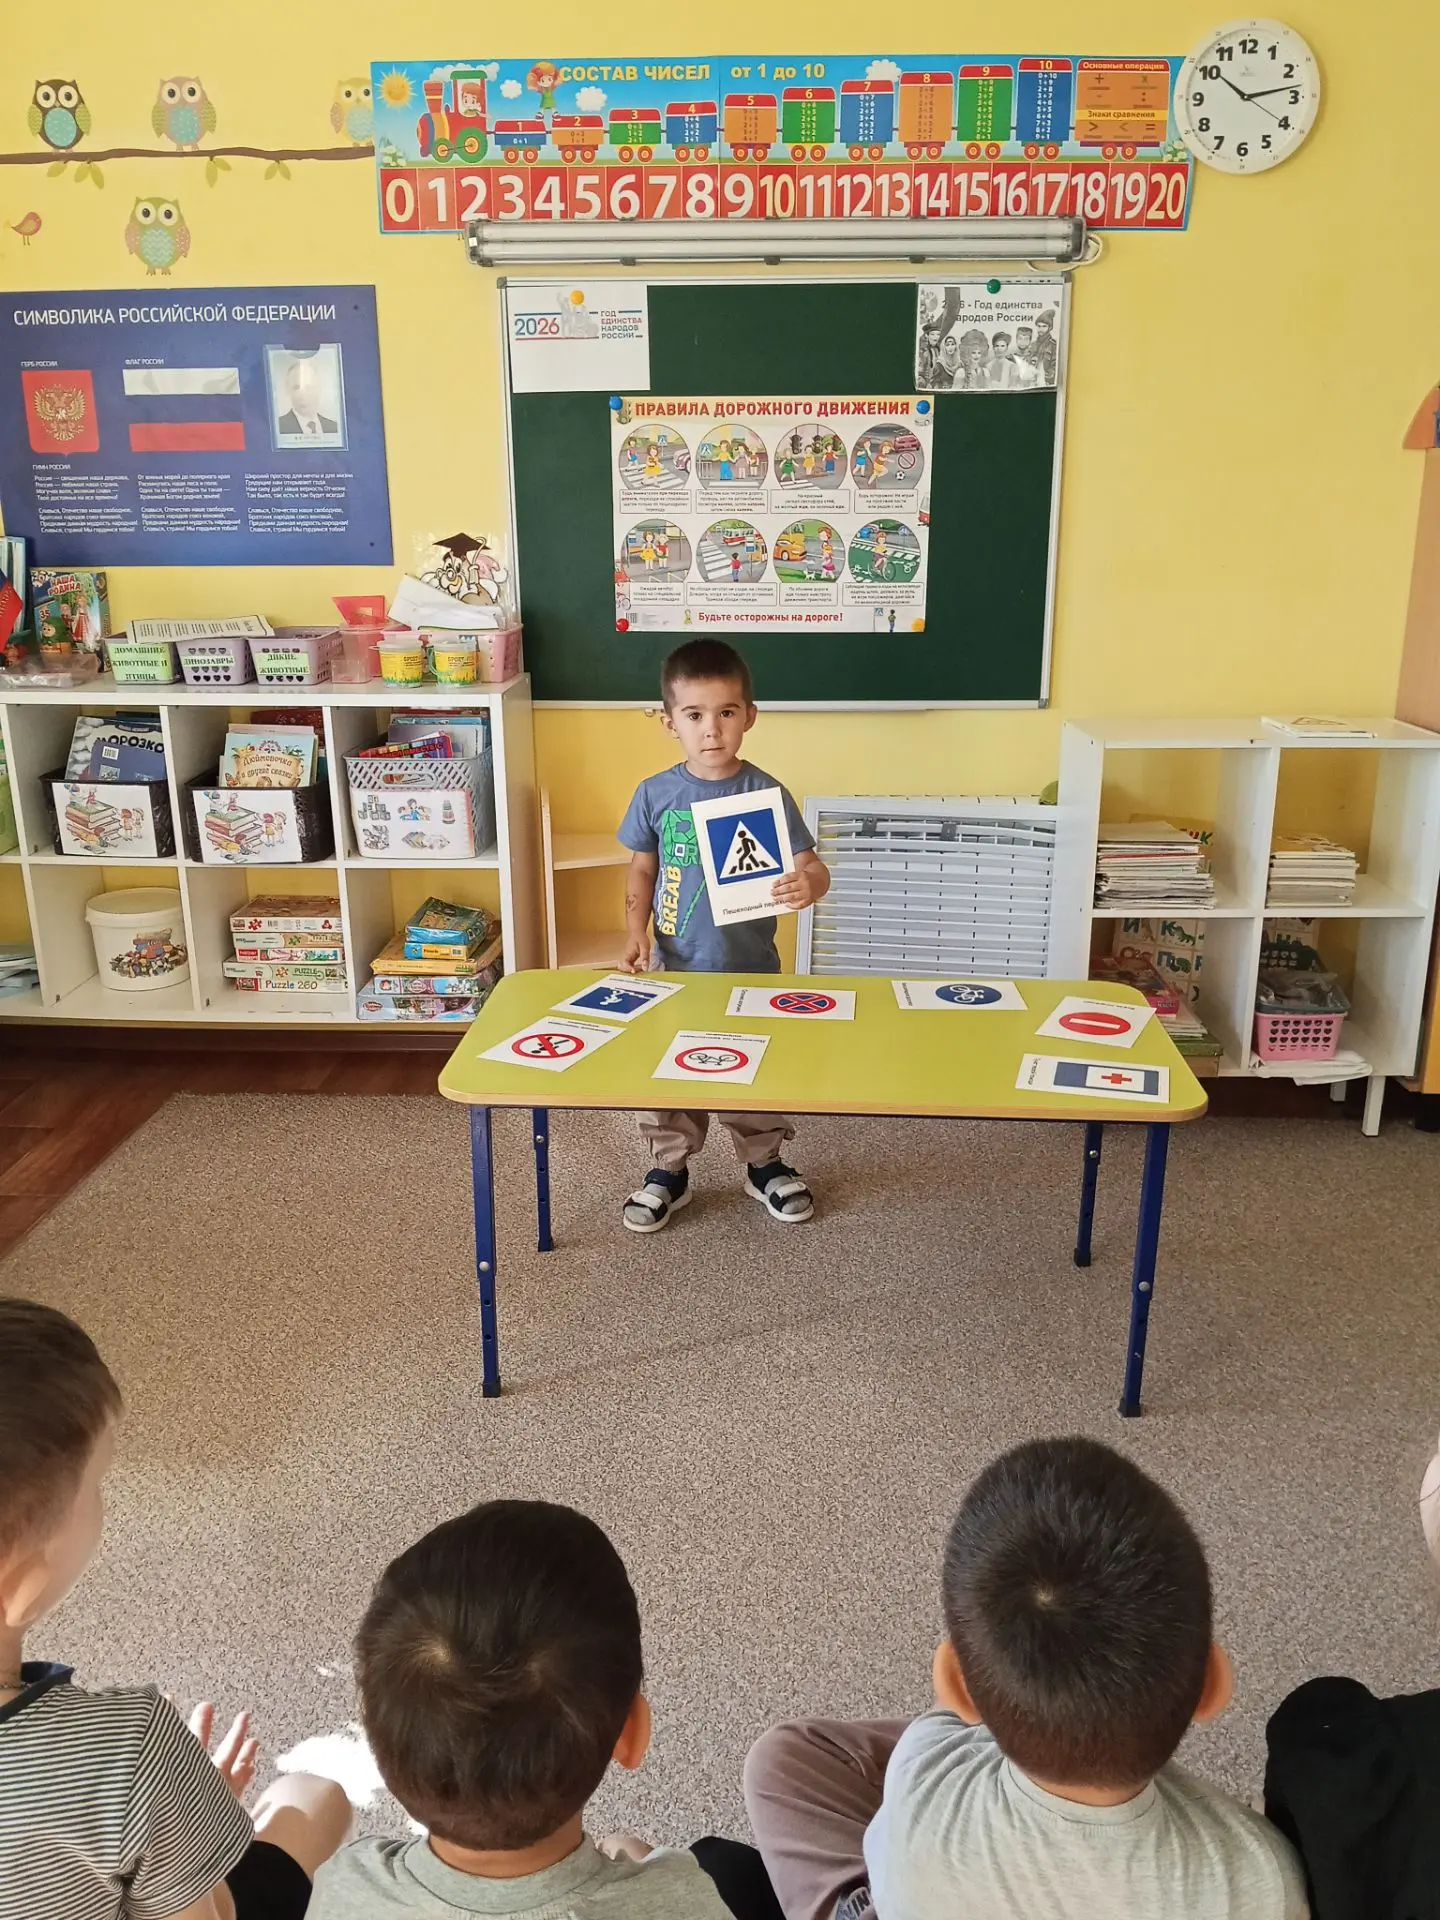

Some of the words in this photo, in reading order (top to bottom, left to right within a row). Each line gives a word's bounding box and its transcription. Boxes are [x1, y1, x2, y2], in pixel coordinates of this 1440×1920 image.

[1239, 39, 1258, 54] 12
[1216, 46, 1233, 61] 11
[1268, 45, 1276, 60] 1
[1040, 61, 1052, 70] 10
[560, 66, 636, 82] СОСТАВ
[644, 64, 711, 81] ЧИСЕЛ
[730, 66, 752, 78] от
[757, 63, 766, 78] 1
[773, 66, 797, 81] до
[803, 64, 825, 78] 10
[982, 67, 990, 76] 9
[1199, 65, 1221, 80] 10
[1283, 64, 1294, 79] 2
[923, 74, 931, 83] 8
[864, 82, 871, 91] 7
[805, 89, 813, 99] 6
[1192, 92, 1204, 106] 9
[1289, 90, 1299, 104] 3
[747, 96, 754, 105] 5
[688, 104, 696, 113] 4
[631, 110, 639, 120] 3
[1113, 111, 1155, 119] сравнения
[517, 122, 523, 131] 1
[574, 117, 581, 126] 2
[1198, 118, 1210, 132] 8
[1278, 116, 1290, 130] 4
[1214, 136, 1224, 150] 7
[1261, 135, 1271, 149] 5
[1237, 143, 1248, 156] 6
[385, 178, 415, 223] 0
[428, 177, 447, 222] 1
[460, 176, 489, 222] 2
[498, 174, 526, 220] 3
[533, 175, 567, 220] 4
[574, 175, 601, 220] 5
[609, 174, 640, 220] 6
[648, 175, 677, 220] 7
[685, 173, 715, 219] 8
[724, 173, 754, 217] 9
[759, 173, 795, 217] 10
[799, 173, 831, 217] 11
[837, 173, 873, 217] 12
[875, 172, 911, 217] 13
[915, 172, 950, 216] 14
[954, 172, 990, 216] 15
[993, 171, 1029, 216] 16
[1031, 171, 1069, 216] 17
[1072, 171, 1106, 219] 18
[1110, 172, 1147, 220] 19
[1148, 172, 1184, 220] 20
[974, 299, 993, 310] Год
[995, 300, 1043, 310] единства
[13, 308, 116, 326] СИМВОЛИКА
[119, 303, 228, 323] РОССИЙСКОЙ
[231, 304, 336, 323] ФЕДЕРАЦИИ
[600, 310, 616, 318] ГОД
[955, 313, 994, 324] ародов
[996, 312, 1034, 322] России
[514, 317, 560, 336] 2026
[601, 317, 642, 325] ЕДИНСТВА
[635, 403, 710, 417] ПРАВИЛА
[713, 401, 815, 418] ДОРОЖНОГО
[817, 401, 910, 418] ДВИЖЕНИЯ
[698, 612, 731, 624] Будьте
[733, 613, 790, 624] осторожны
[791, 613, 804, 622] на
[805, 612, 843, 624] дороге!
[113, 646, 165, 655] ДОМАШНИЕ
[184, 657, 234, 666] ДИНОЗАВРЫ
[267, 653, 297, 662] ДИКИЕ
[112, 660, 160, 668] ЖИВОТНЫЕ
[260, 666, 309, 674] ЖИВОТНЫЕ
[125, 673, 156, 681] ПТИЦЫ
[722, 902, 763, 915] Пешеходный
[265, 980, 295, 990] Puzzle
[297, 981, 318, 990] 260
